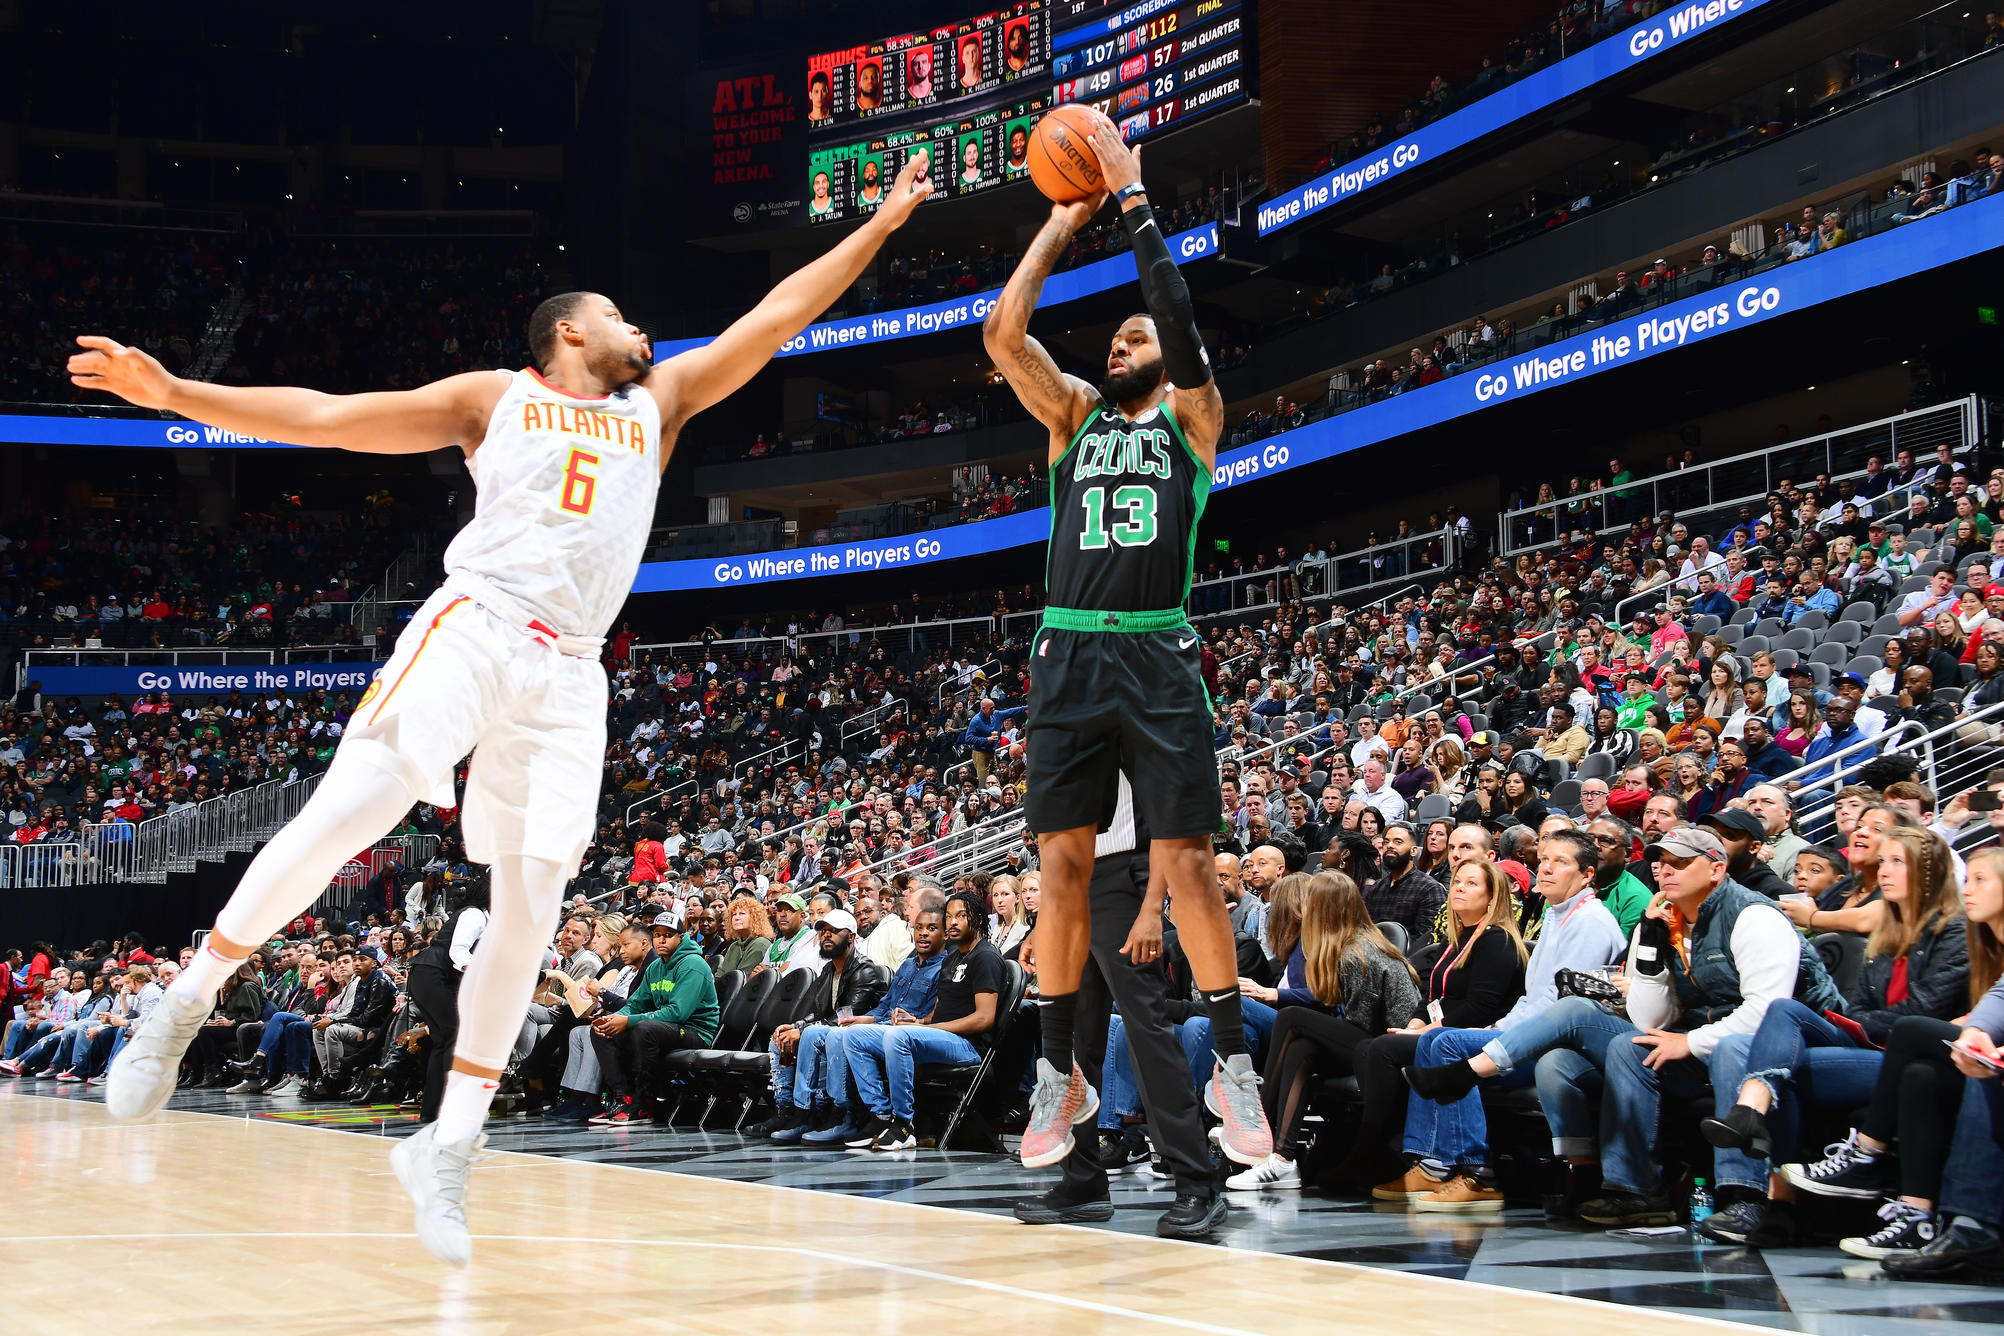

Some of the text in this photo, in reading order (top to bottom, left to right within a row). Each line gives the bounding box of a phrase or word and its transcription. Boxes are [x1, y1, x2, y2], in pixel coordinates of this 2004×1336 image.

[1000, 6, 1023, 20] FLS 2
[1072, 2, 1085, 14] 1ST
[1124, 0, 1177, 24] SCOREBO
[976, 16, 994, 29] 50%
[936, 29, 950, 40] 0%
[1086, 41, 1114, 66] 107
[1150, 14, 1177, 40] 112
[1197, 0, 1223, 16] FINAL
[1155, 44, 1172, 68] 57
[1181, 36, 1197, 53] 2nd
[1199, 18, 1240, 45] QUARTER
[1630, 28, 1664, 56] Go
[887, 38, 911, 52] 58.3%
[811, 46, 866, 71] HAWKS
[1022, 64, 1045, 77] BEMBRY
[1155, 49, 1239, 97] 26 1st QUARTER
[975, 78, 1000, 92] HUERTER
[1090, 71, 1110, 91] 49
[713, 74, 792, 113] ATL,
[925, 96, 937, 104] LEN
[1032, 97, 1052, 110] TOL 7
[1156, 79, 1240, 127] 17 1st QUARTER
[713, 107, 795, 130] WELCOME
[875, 103, 905, 115] SPELLMAN
[1002, 105, 1024, 119] FLS 3
[824, 118, 834, 126] LIN
[976, 114, 998, 129] 100%
[713, 126, 782, 148] TO YOUR
[888, 134, 912, 148] 68.4%
[935, 127, 954, 138] 60%
[714, 148, 752, 167] NEW
[811, 144, 867, 166] CELTICS
[1050, 128, 1100, 186] SPALDING
[960, 186, 968, 195] 20
[976, 177, 1000, 190] HAYWARD
[1007, 173, 1015, 181] 36
[1304, 187, 1328, 211] the
[1332, 158, 1389, 198] Players
[1393, 144, 1419, 168] Go
[825, 211, 843, 220] TATUM
[860, 206, 867, 214] 13
[1182, 236, 1207, 257] Go
[811, 326, 867, 347] Where
[872, 318, 900, 337] the
[906, 305, 968, 331] Players
[1475, 287, 1780, 402] Go Where the Players Go
[166, 426, 199, 443] Go
[523, 402, 646, 455] ATLANTA
[1073, 428, 1172, 482] CELTICS
[1263, 445, 1289, 469] Go
[560, 447, 601, 517] 6
[1080, 485, 1158, 551] 13
[714, 538, 940, 582] Go Where the Players Go
[138, 672, 172, 690] Go
[178, 672, 248, 689] Where
[255, 671, 289, 688] the
[296, 670, 365, 690] Players
